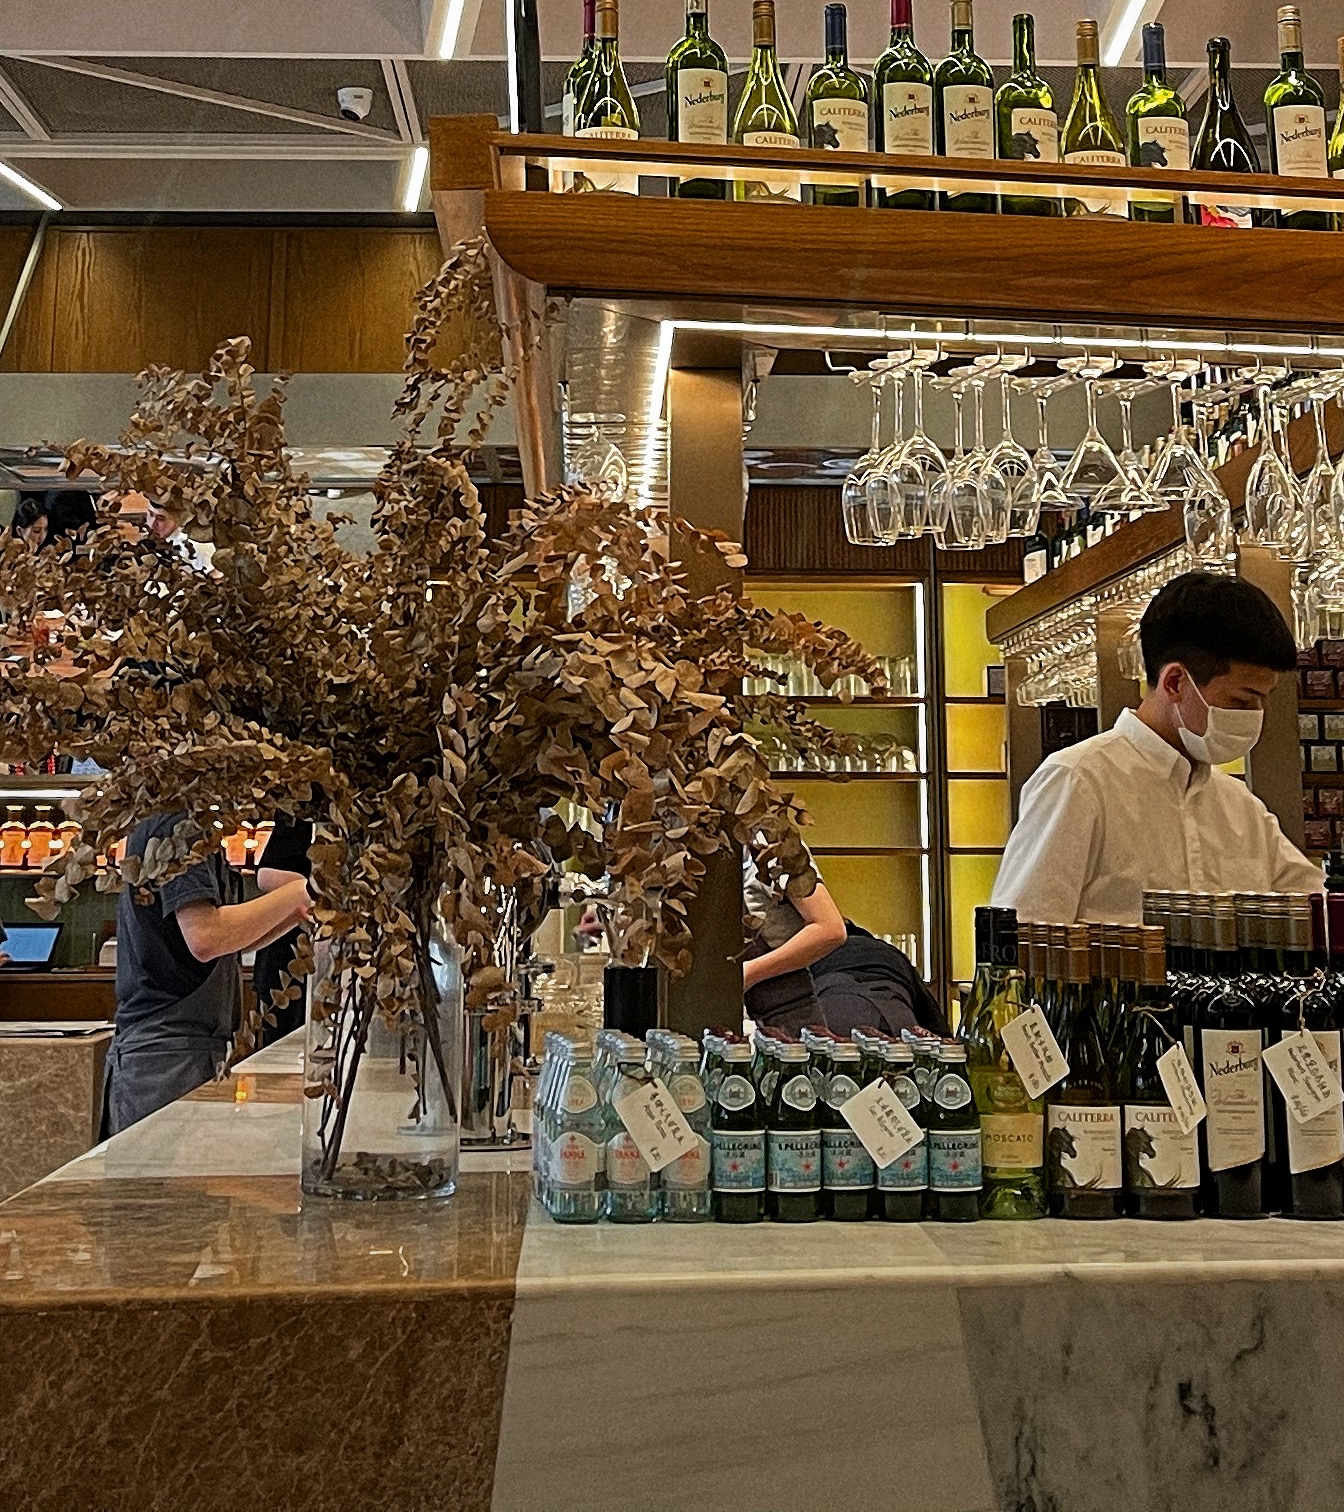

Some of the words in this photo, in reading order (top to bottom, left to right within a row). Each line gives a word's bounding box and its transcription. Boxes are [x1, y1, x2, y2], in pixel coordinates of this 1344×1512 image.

[684, 90, 725, 108] Nederburg
[889, 103, 930, 122] Nederburg
[949, 106, 990, 124] Nederburg
[1280, 125, 1322, 146] Nederburg
[1208, 1056, 1259, 1079] Nederburg
[1057, 1111, 1116, 1123] CALITERRA
[985, 1133, 1034, 1143] MOSCATO
